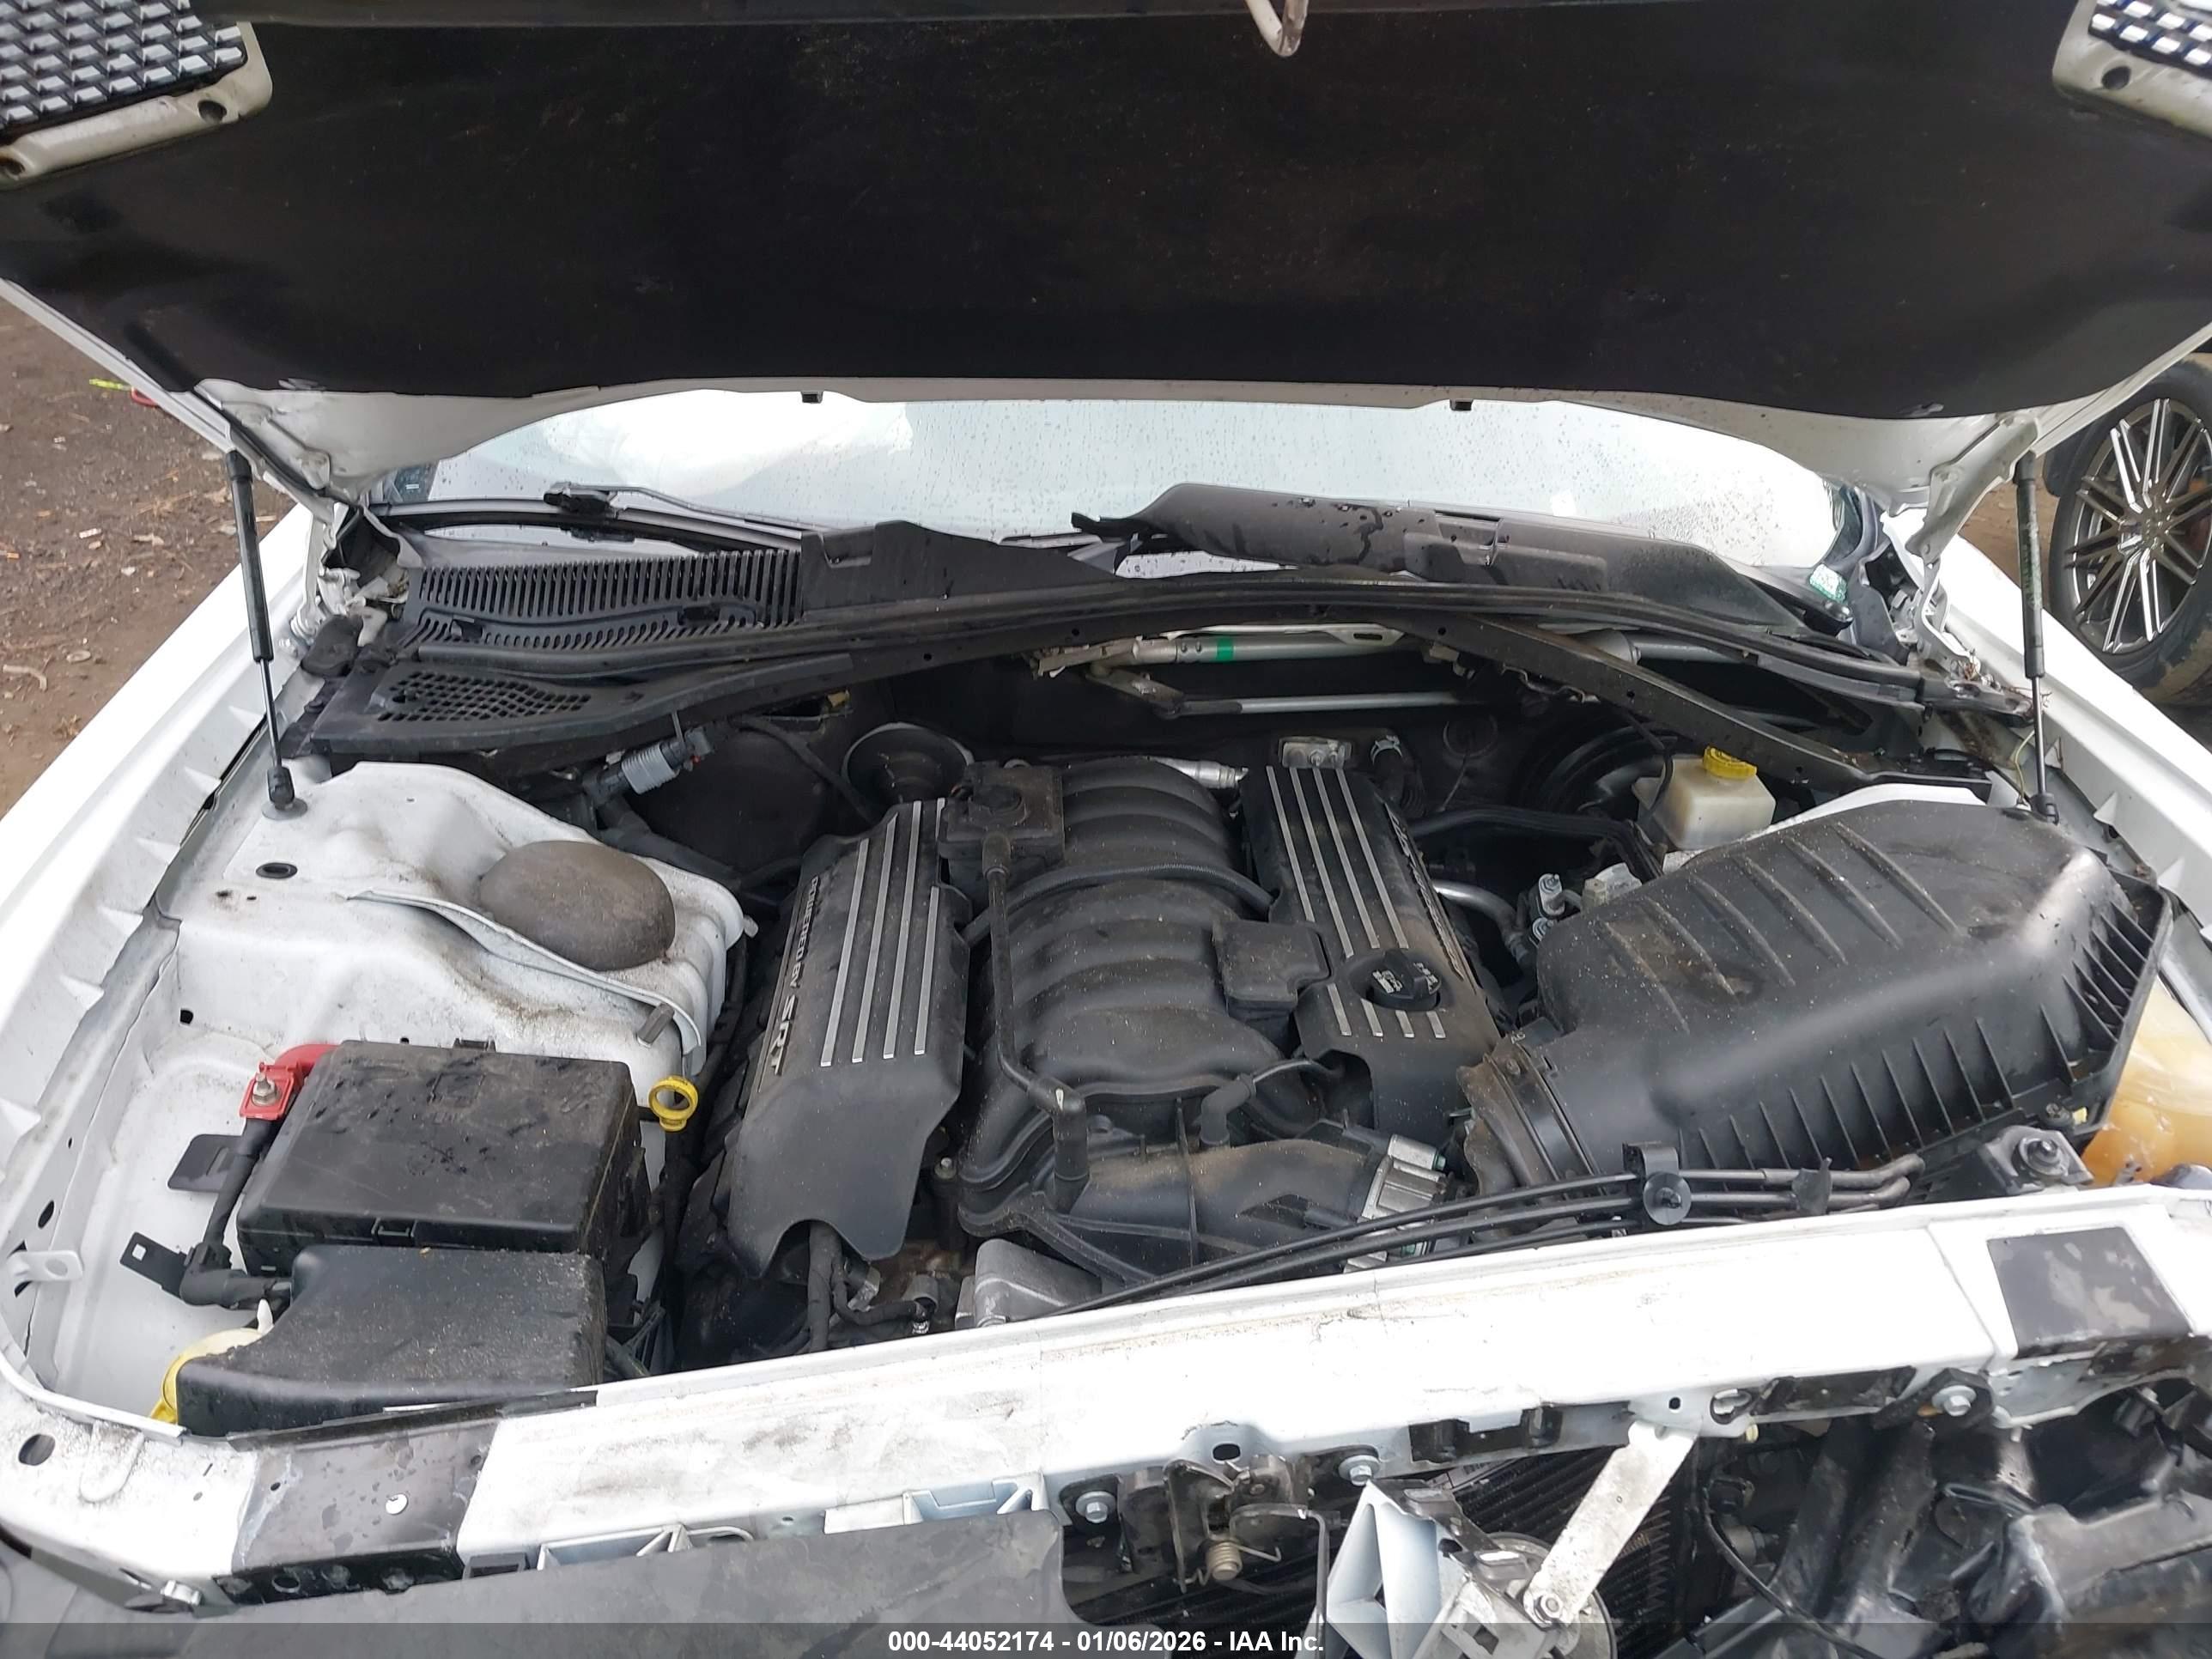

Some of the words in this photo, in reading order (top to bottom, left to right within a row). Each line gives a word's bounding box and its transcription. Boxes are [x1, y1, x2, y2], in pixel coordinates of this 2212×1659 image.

[796, 876, 818, 962] POWERED
[790, 962, 801, 988] BY
[770, 994, 796, 1075] SRT
